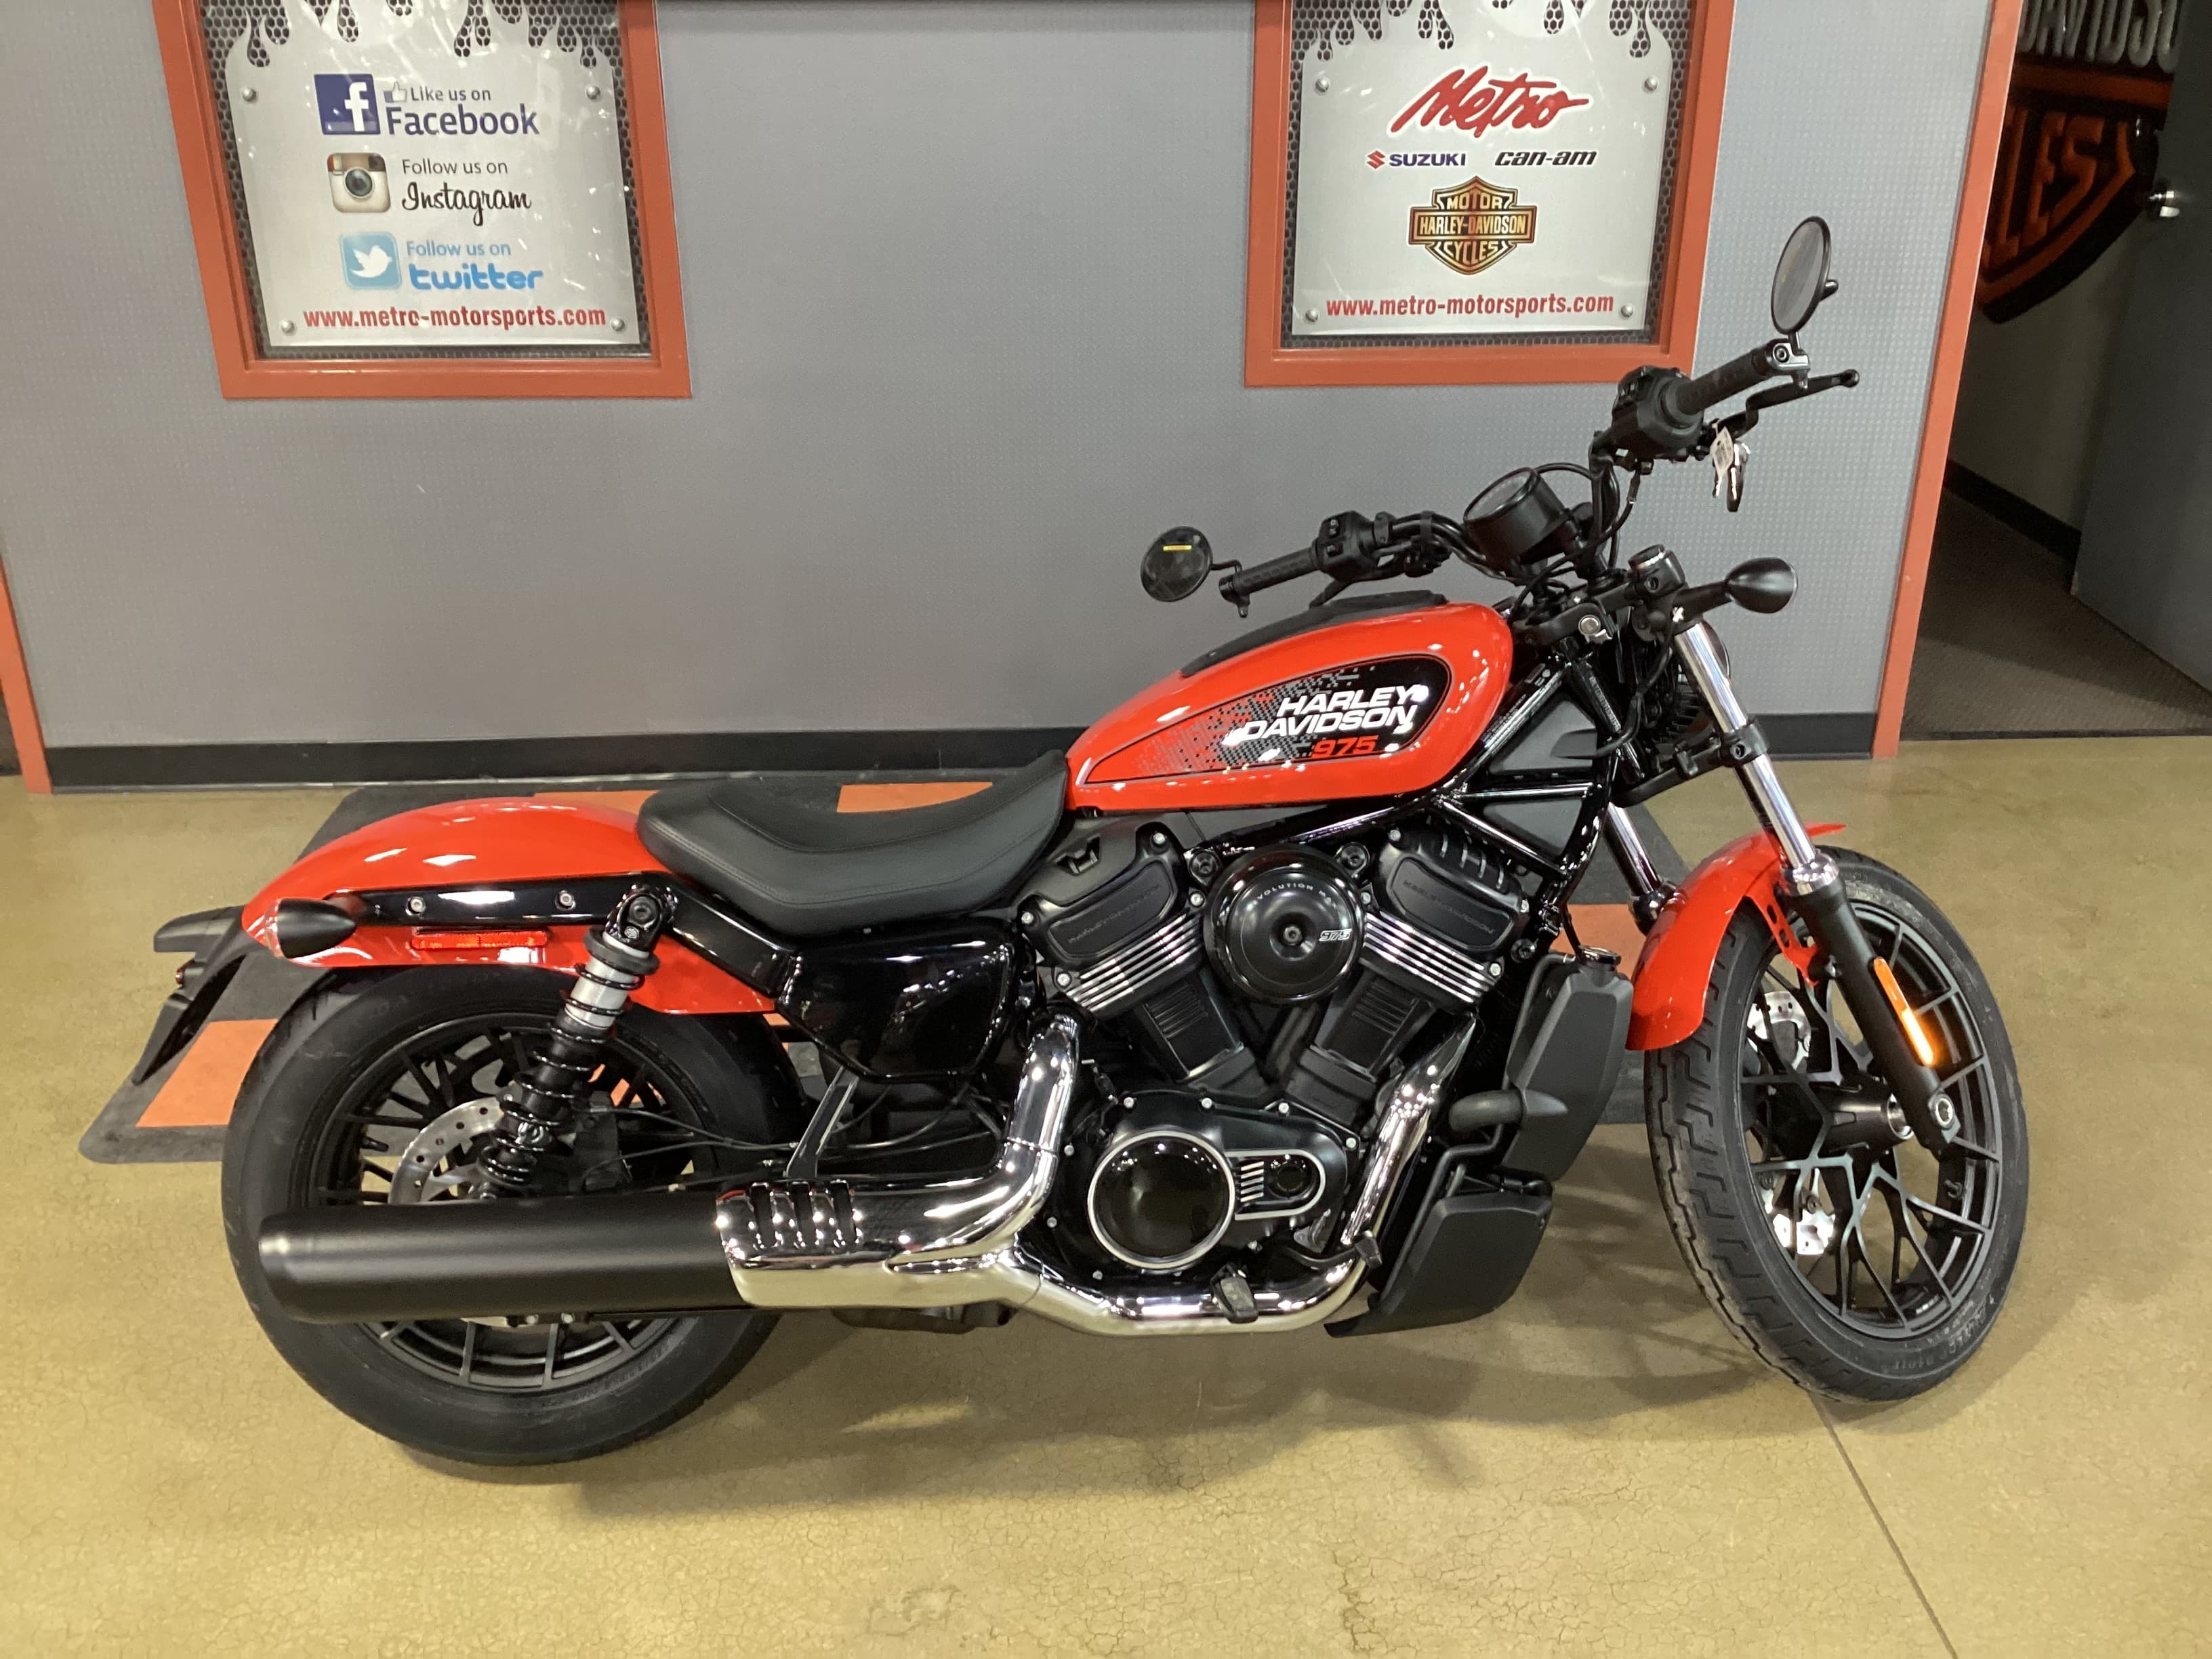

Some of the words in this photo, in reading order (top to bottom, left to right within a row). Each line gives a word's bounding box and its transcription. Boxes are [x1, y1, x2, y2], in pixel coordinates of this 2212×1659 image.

[410, 87, 444, 101] Like
[449, 89, 467, 101] us
[471, 89, 491, 101] on
[1391, 66, 1589, 138] Metro
[386, 104, 540, 135] Facebook
[402, 159, 458, 174] Follow
[463, 161, 482, 174] us
[487, 161, 508, 174] on
[1389, 153, 1467, 167] SUZUKI
[1494, 151, 1597, 166] can-am
[402, 182, 532, 226] Instagram
[1446, 189, 1503, 209] MOTOR
[1419, 216, 1527, 235] HARLEY-DAVIDSON
[407, 240, 461, 256] Follow
[466, 242, 485, 256] us
[489, 241, 511, 256] on
[1443, 242, 1499, 266] CYCLES
[409, 263, 544, 290] twitter
[1326, 293, 1614, 318] www.metro-motorsports.com
[303, 306, 607, 330] www.metro-motorsports.com
[1276, 684, 1427, 717] HARLEY
[1239, 705, 1418, 740] DAVIDSON
[1311, 735, 1379, 759] 975
[1247, 882, 1314, 909] VOLUTION
[1318, 928, 1353, 942] 975
